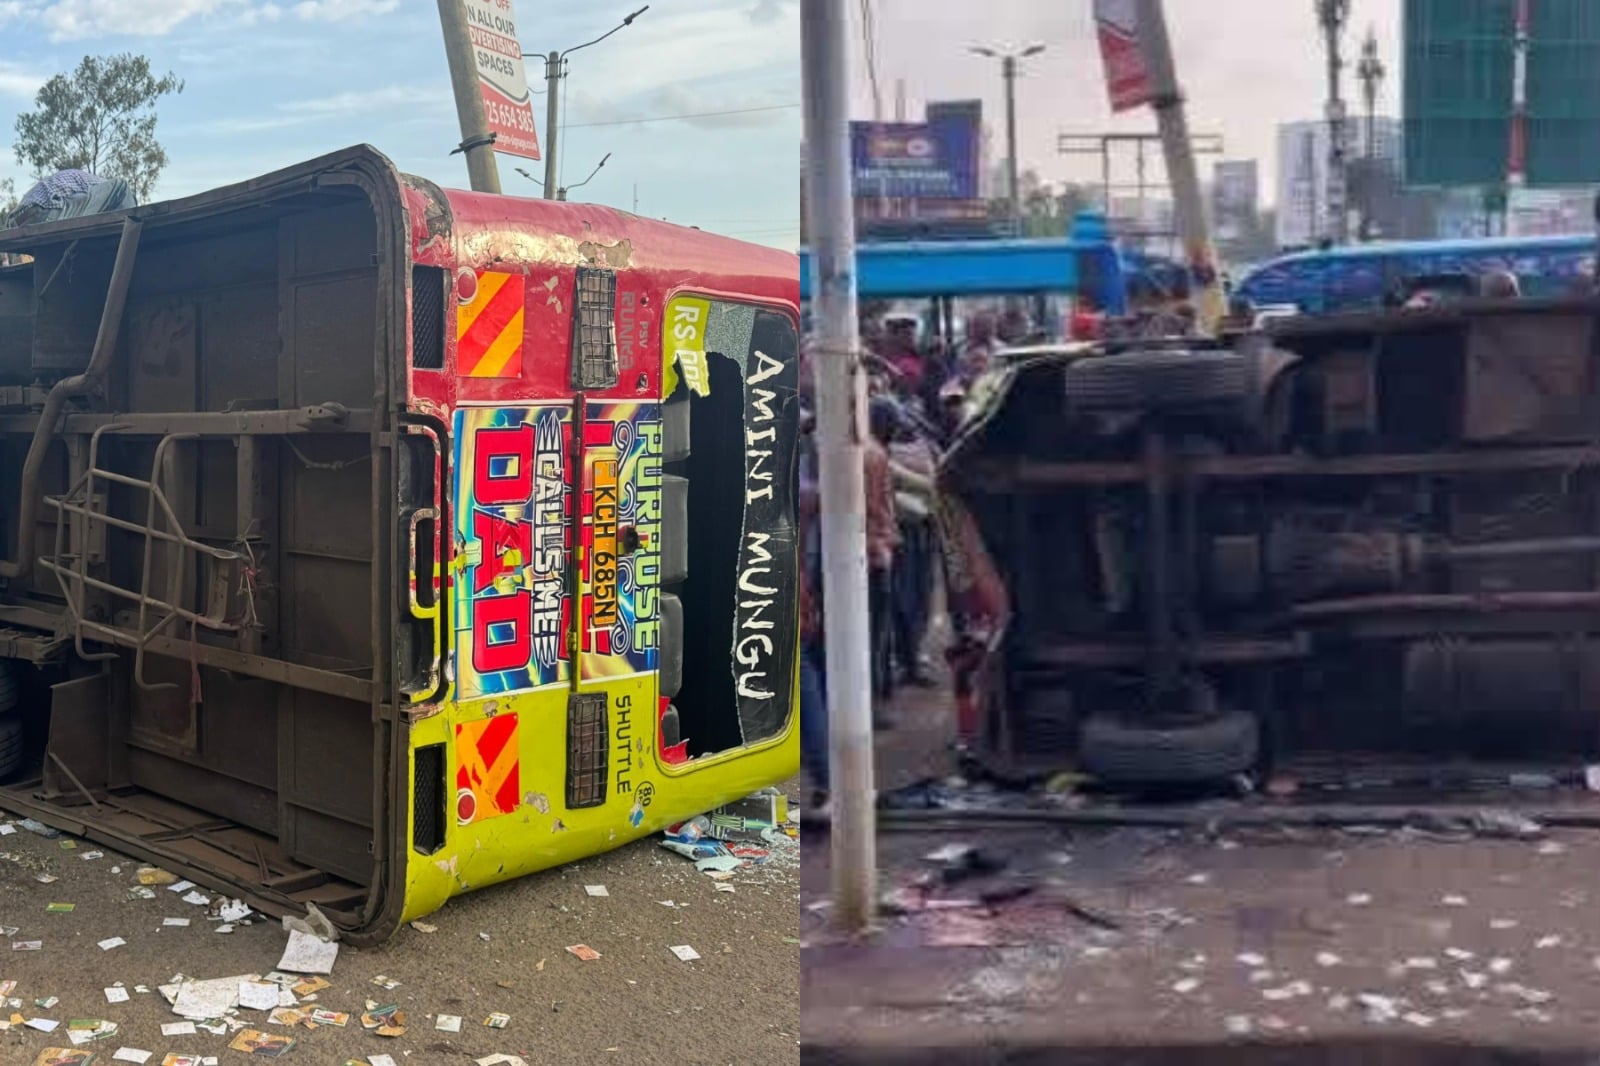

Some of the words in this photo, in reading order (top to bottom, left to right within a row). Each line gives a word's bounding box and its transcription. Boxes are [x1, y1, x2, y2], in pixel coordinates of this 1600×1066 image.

[465, 4, 476, 22] N
[477, 9, 495, 29] ALL
[495, 16, 516, 37] OUR
[469, 26, 521, 59] DVERTISING
[477, 52, 515, 77] SPACES
[483, 98, 499, 125] 25
[499, 103, 517, 129] 654
[516, 107, 534, 133] 385
[639, 320, 649, 349] PSV
[673, 304, 700, 341] RS
[746, 350, 785, 505] AMINI
[595, 486, 616, 539] KCH
[472, 419, 536, 674] DAD
[634, 421, 663, 653] PURPOSE
[595, 551, 616, 619] 685N
[735, 531, 778, 700] MUNGU
[616, 695, 632, 794] SHUTTLE
[642, 786, 653, 807] 80
